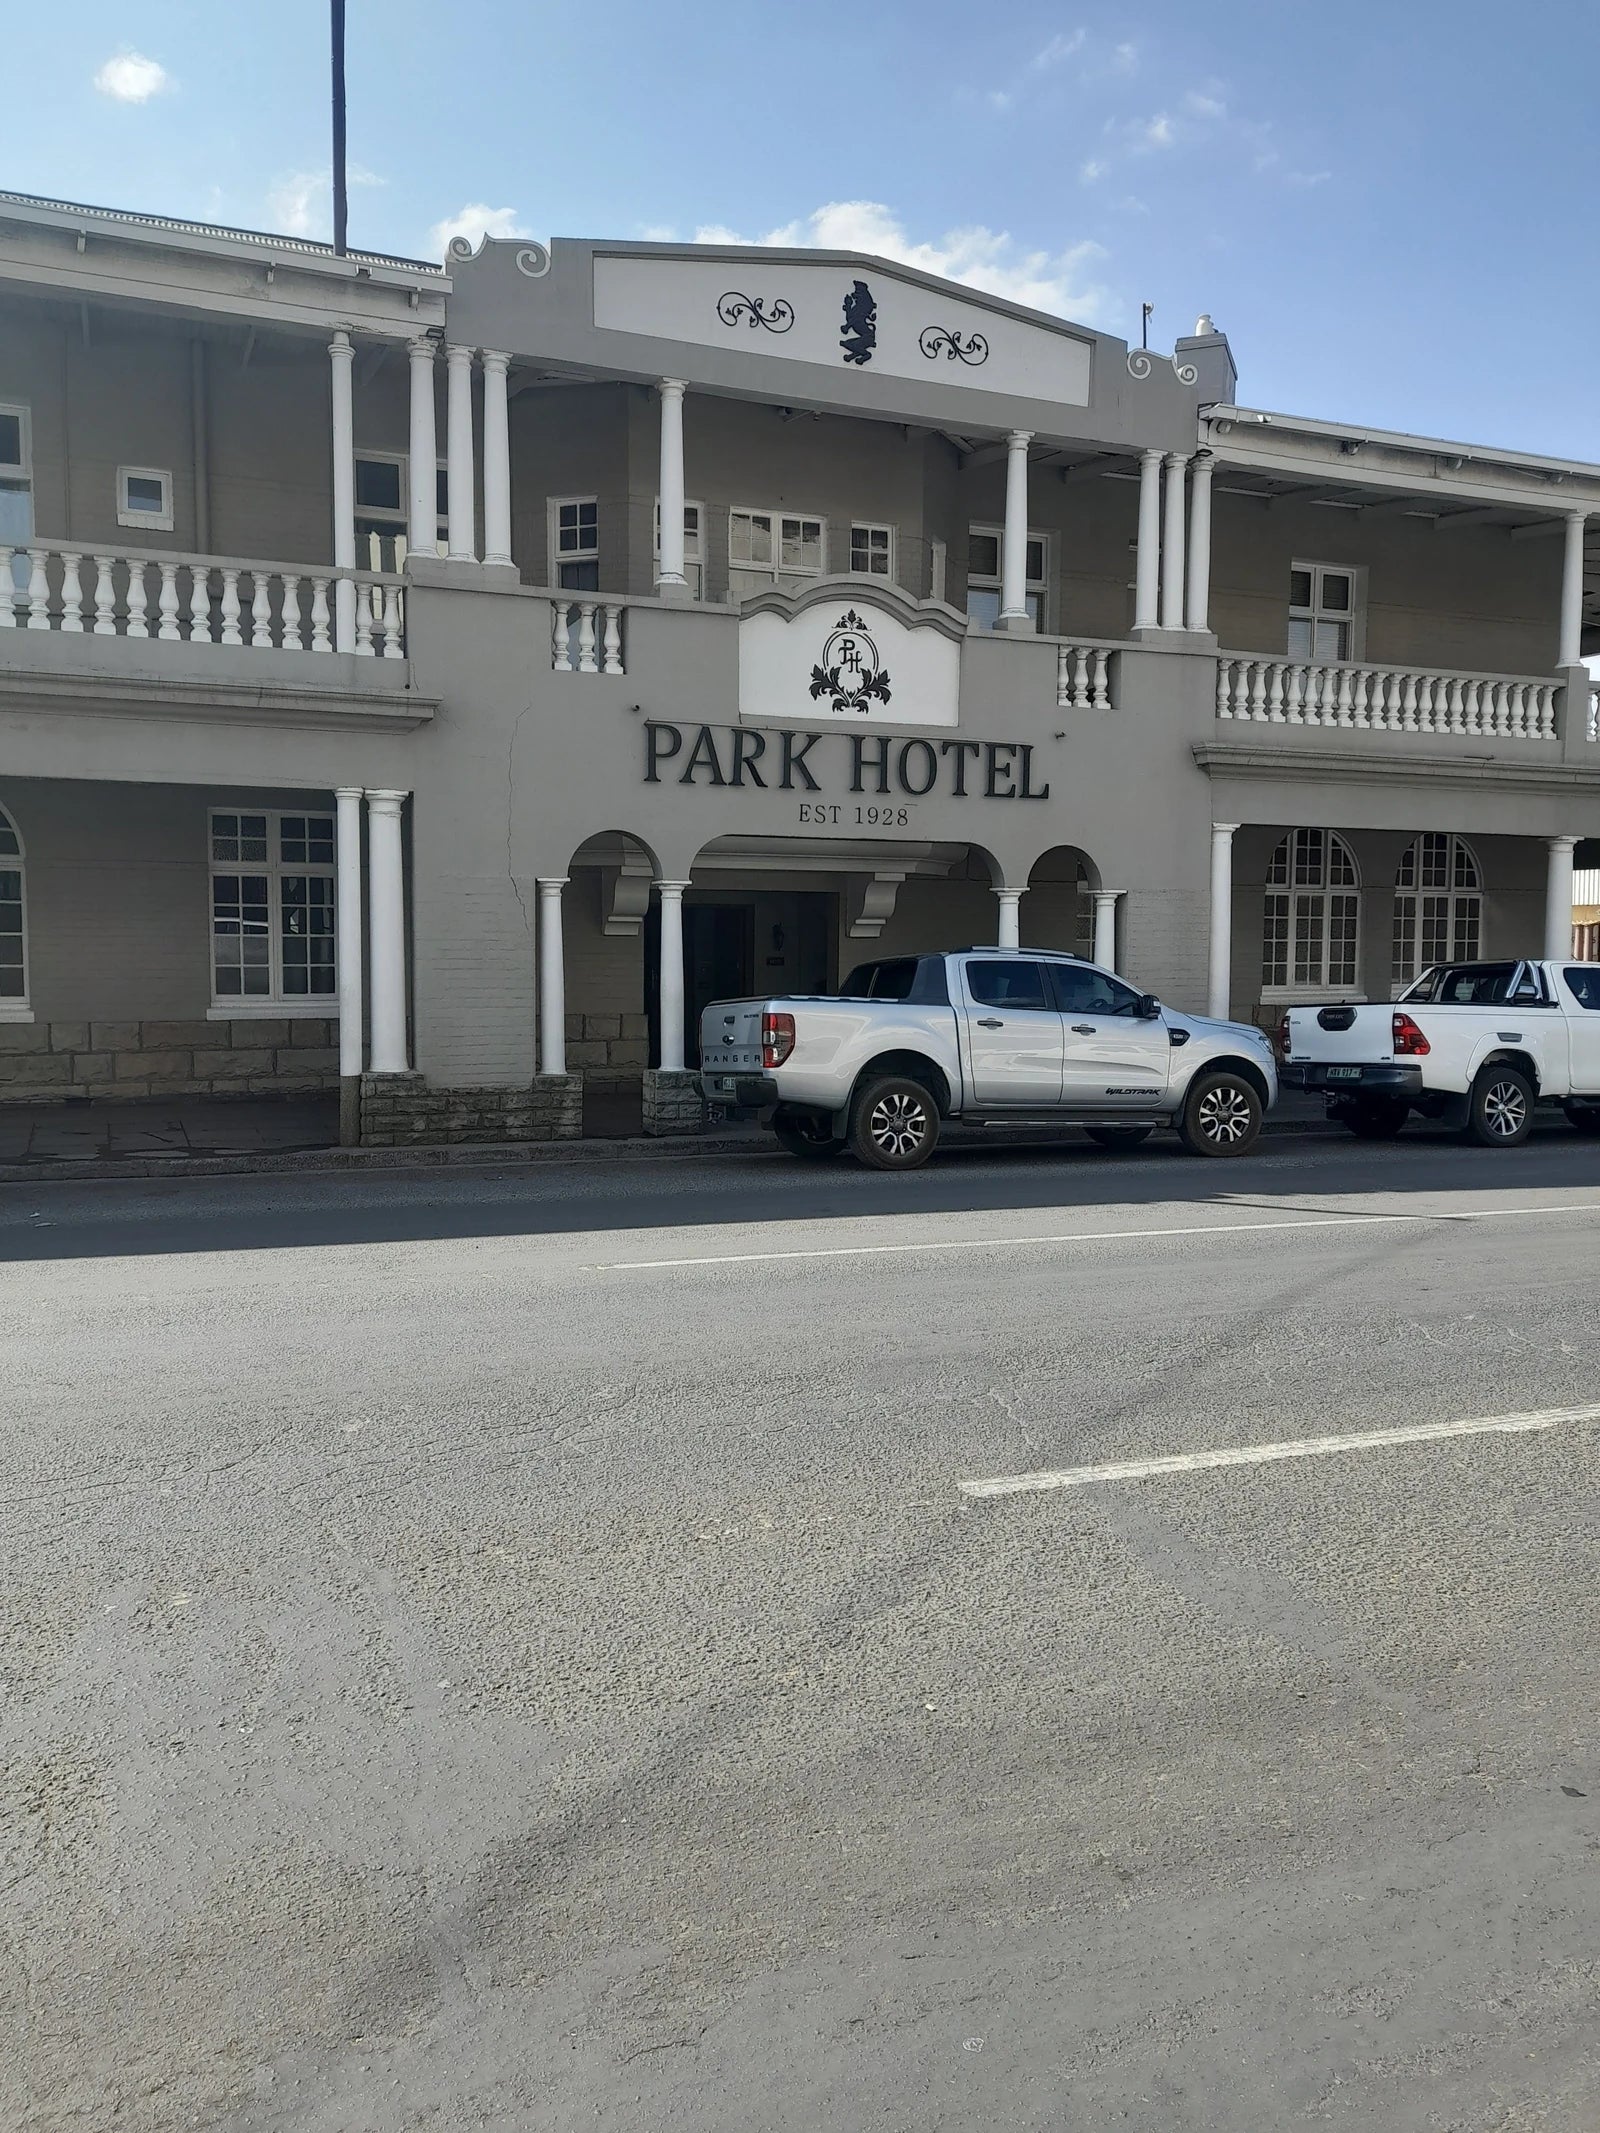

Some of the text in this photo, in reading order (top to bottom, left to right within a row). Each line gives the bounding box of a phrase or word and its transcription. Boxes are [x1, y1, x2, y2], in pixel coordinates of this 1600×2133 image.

[643, 722, 1050, 799] PARK HOTEL
[799, 803, 909, 827] EST 1928
[1105, 1087, 1161, 1096] WILDTRAK
